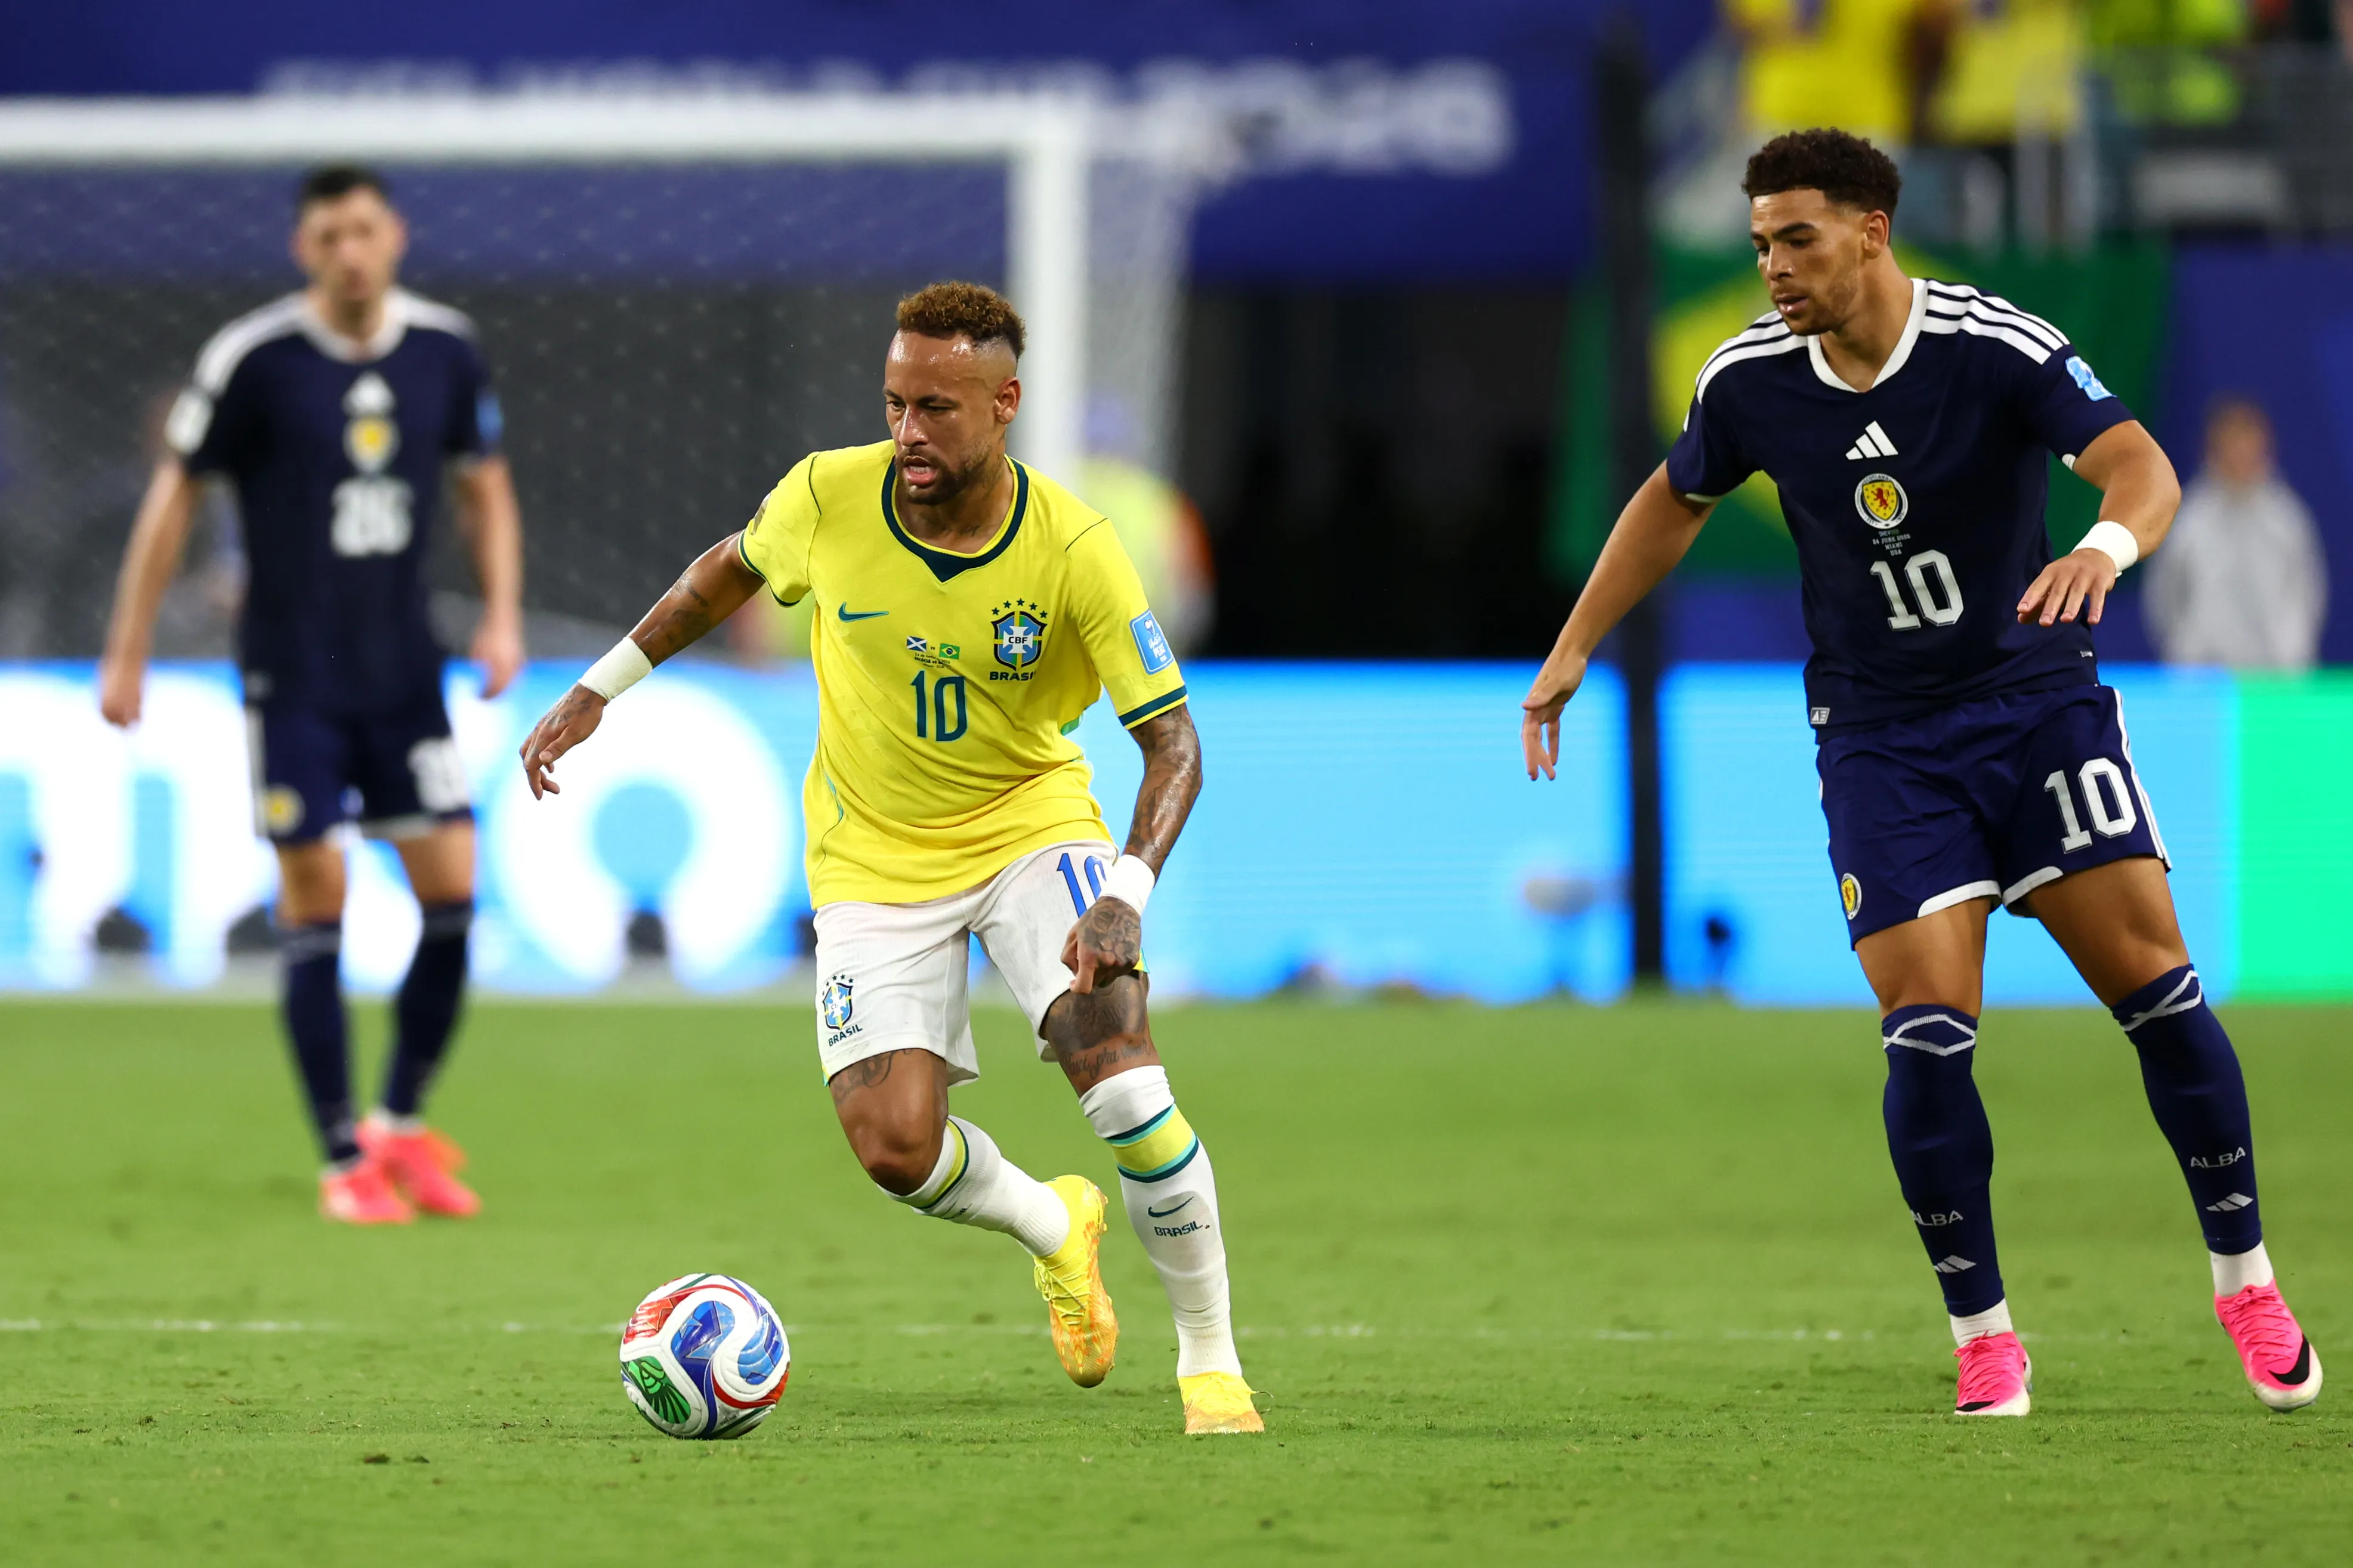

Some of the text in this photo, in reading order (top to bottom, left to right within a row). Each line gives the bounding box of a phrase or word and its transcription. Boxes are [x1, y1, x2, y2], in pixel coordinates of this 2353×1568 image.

[1870, 549, 1964, 631] 10
[909, 670, 968, 742] 10
[2044, 757, 2138, 855] 10
[828, 1024, 863, 1047] BRASIL
[2190, 1146, 2246, 1168] ALBA
[1154, 1220, 1203, 1237] BRASIL
